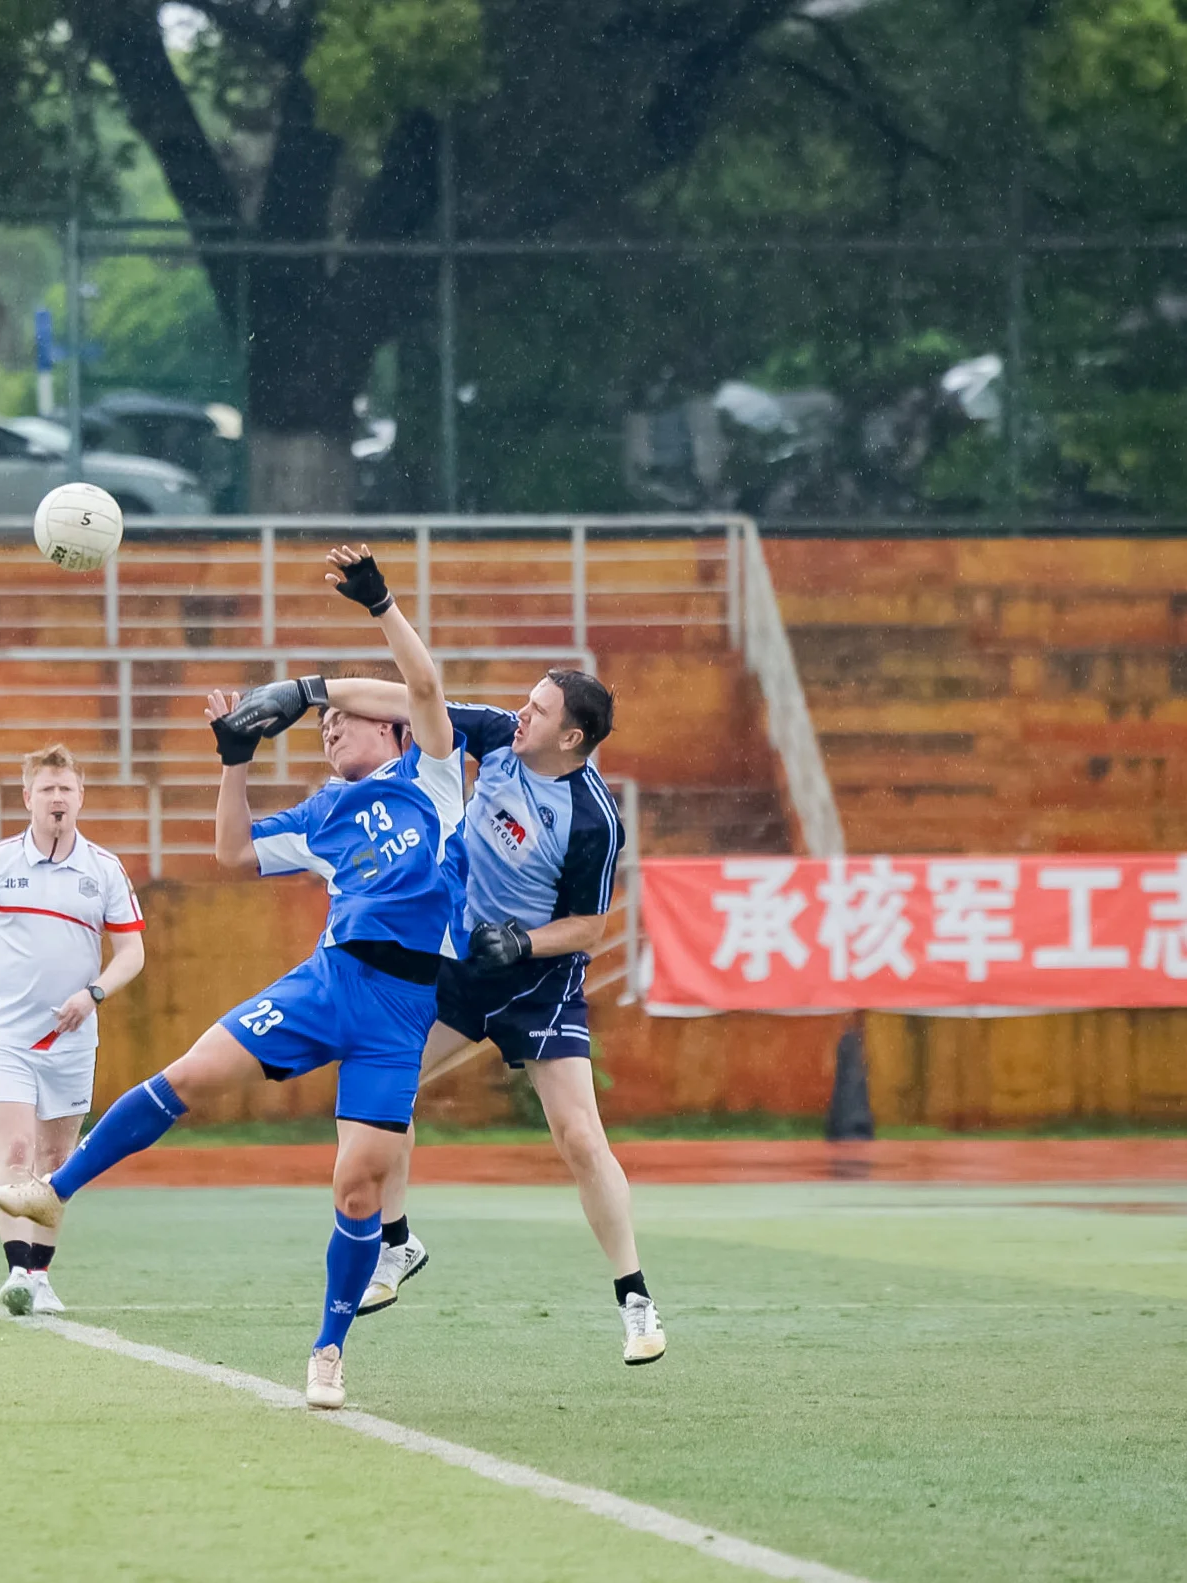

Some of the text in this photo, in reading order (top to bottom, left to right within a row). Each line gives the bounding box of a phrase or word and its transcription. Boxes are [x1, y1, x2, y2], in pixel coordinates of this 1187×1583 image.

[80, 512, 93, 526] 5
[355, 800, 393, 842] 23
[379, 818, 421, 863] TUS
[5, 877, 29, 889] 北京
[238, 999, 284, 1036] 23
